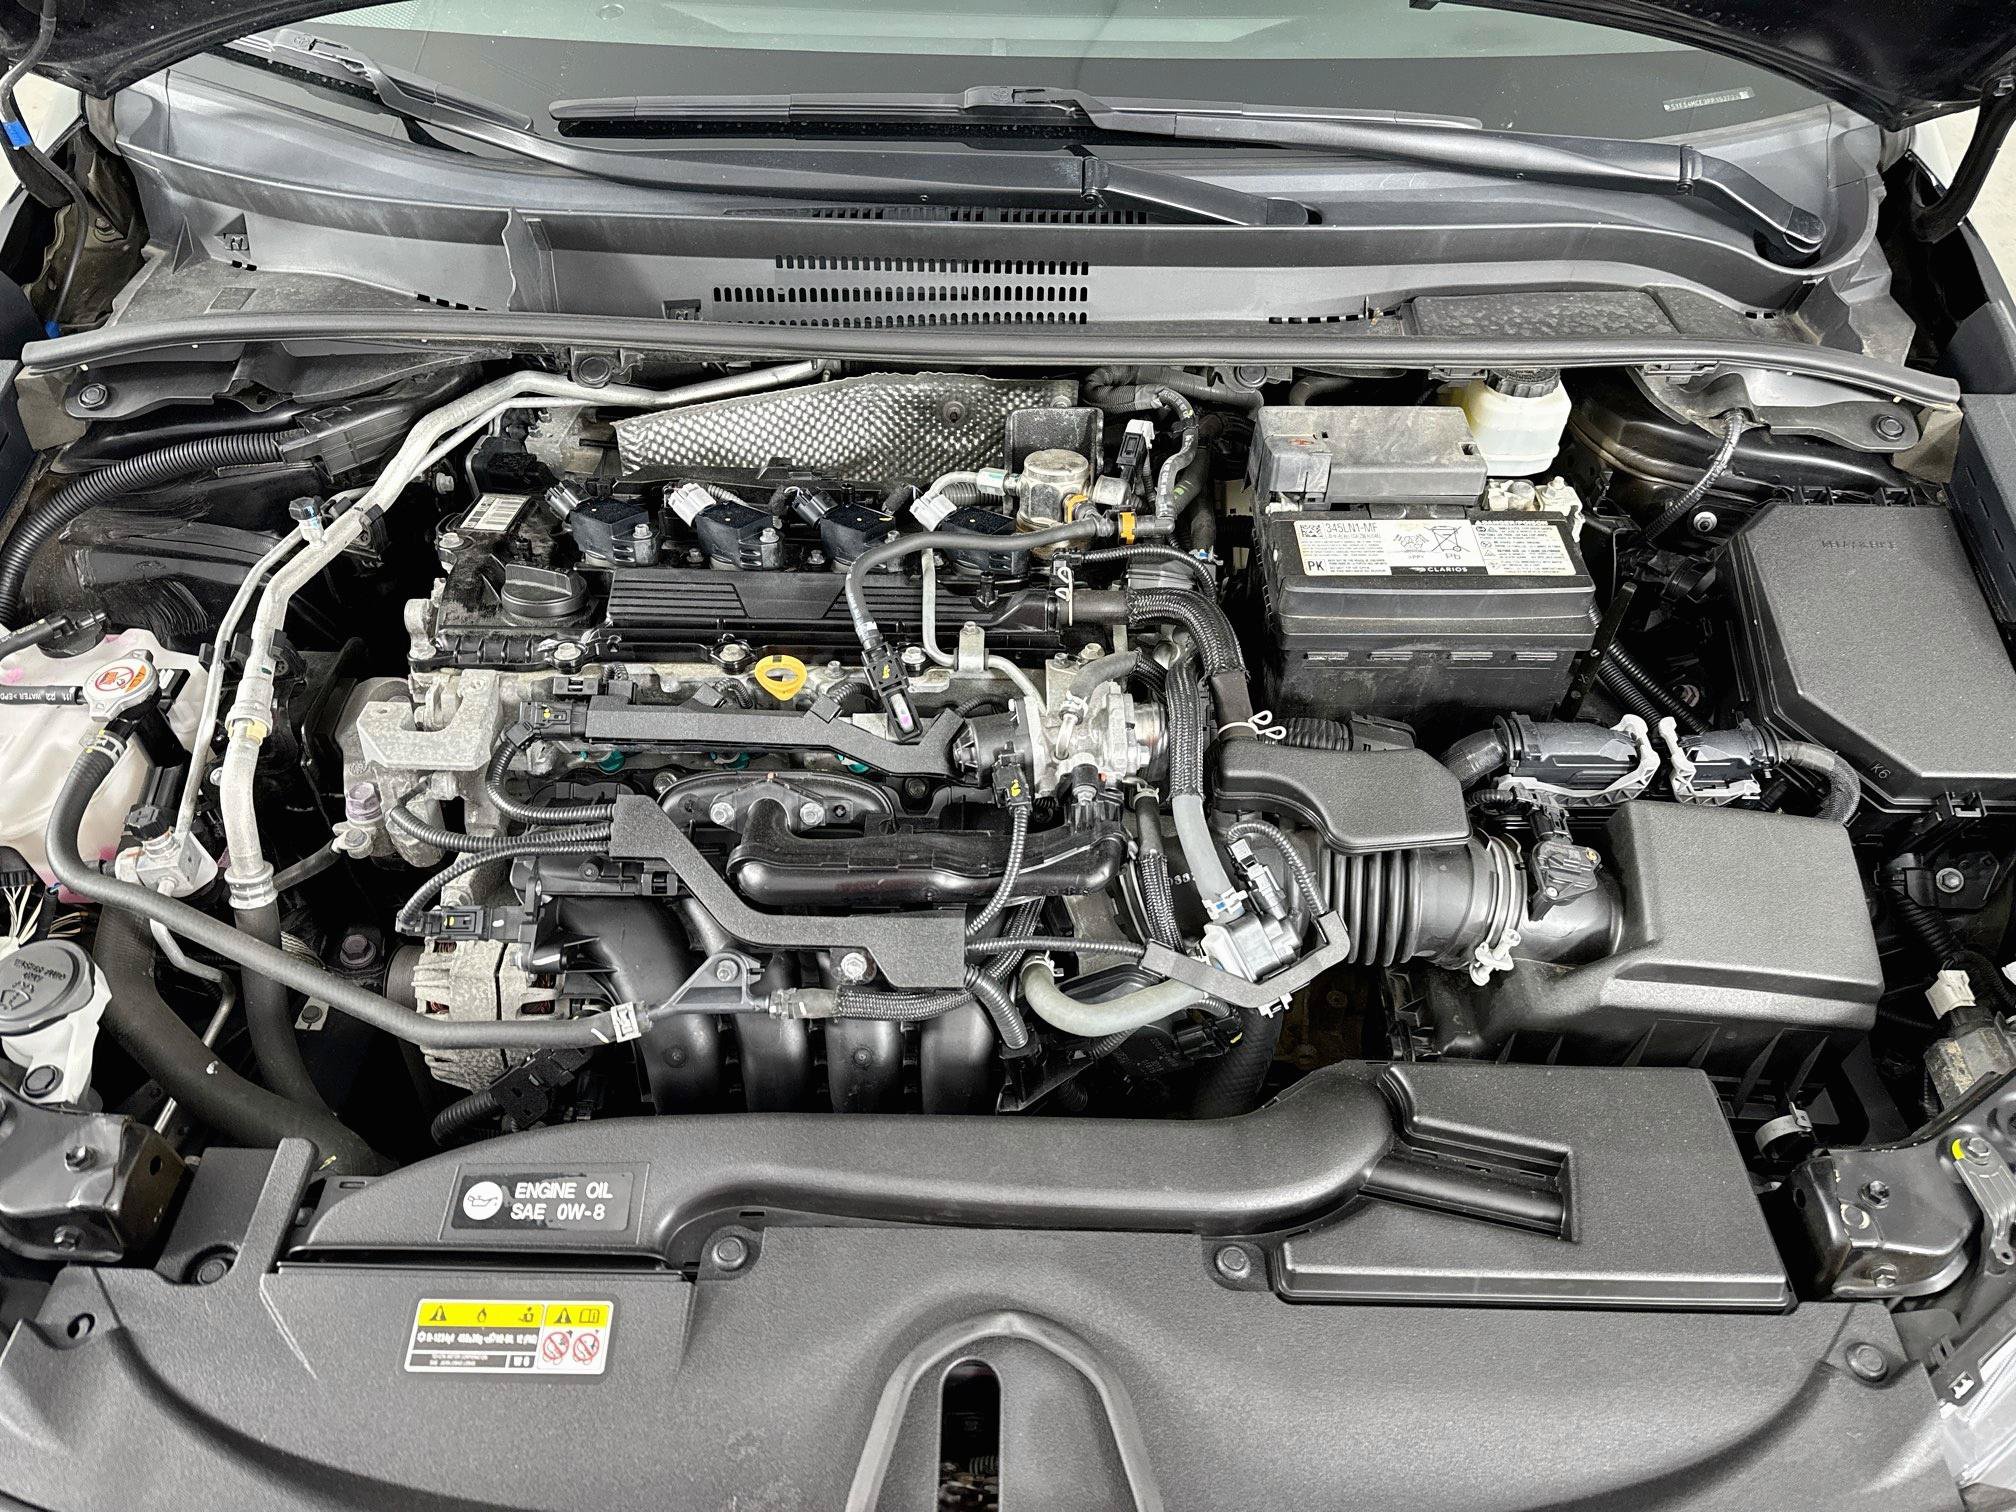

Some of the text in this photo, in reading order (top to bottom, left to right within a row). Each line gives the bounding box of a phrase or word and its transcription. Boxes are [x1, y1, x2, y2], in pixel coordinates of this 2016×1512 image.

[1326, 522, 1378, 533] 345LN1-MF
[1308, 561, 1325, 572] PK
[514, 1182, 613, 1199] ENGINE OIL
[510, 1203, 605, 1221] SAE 0W-8
